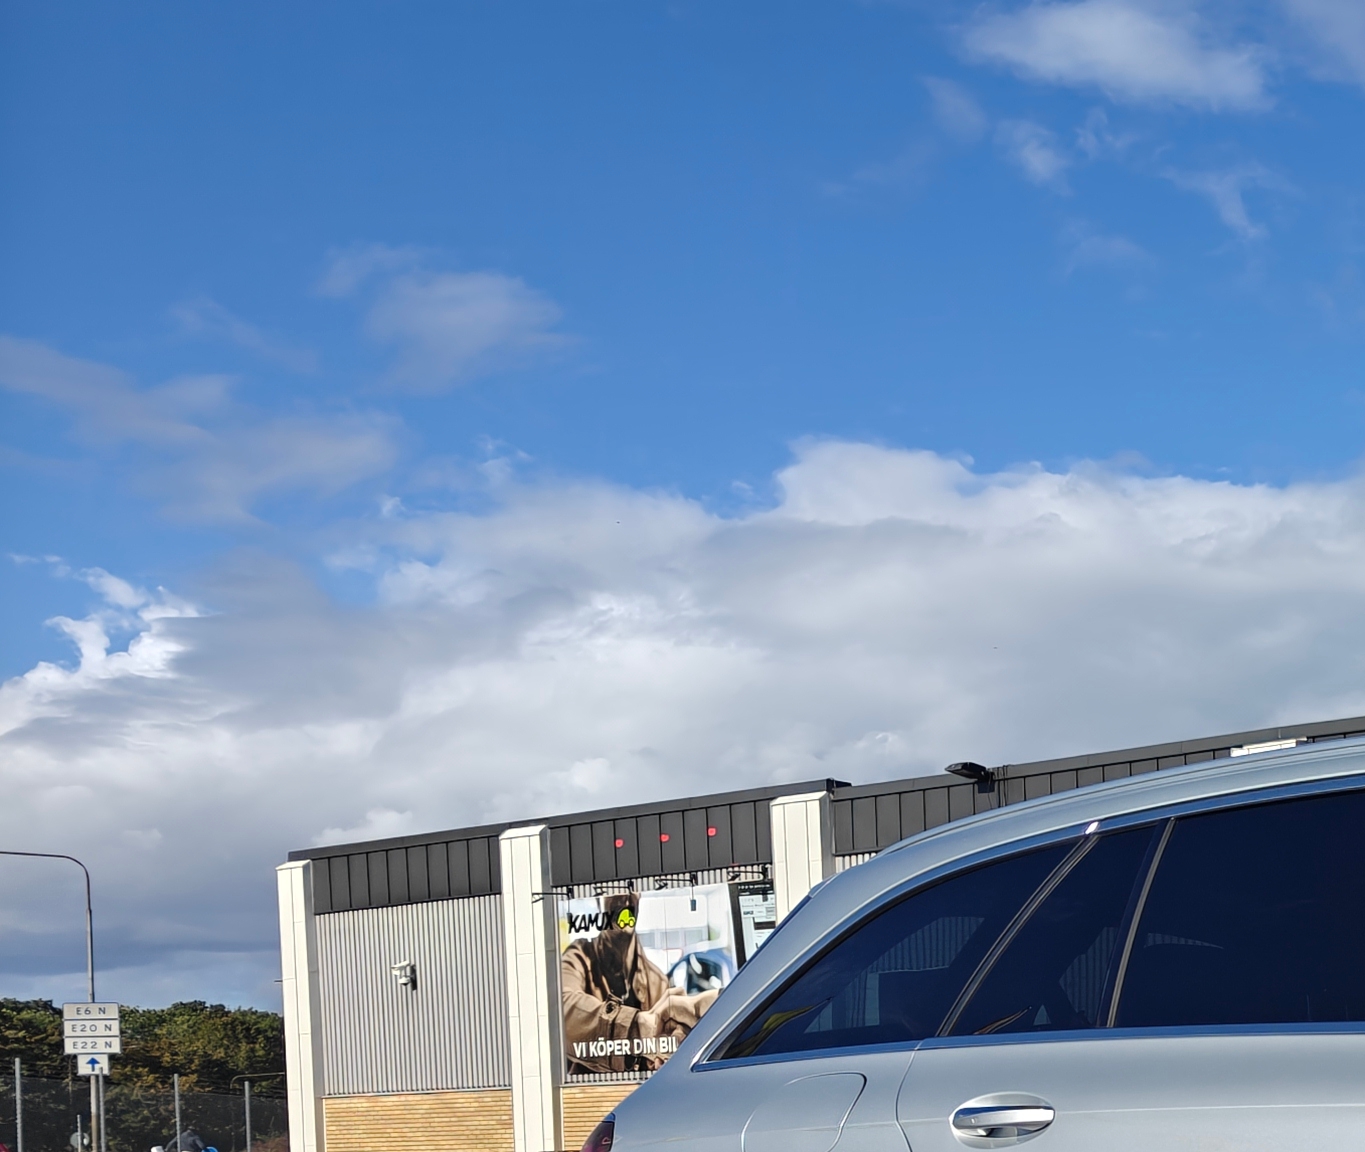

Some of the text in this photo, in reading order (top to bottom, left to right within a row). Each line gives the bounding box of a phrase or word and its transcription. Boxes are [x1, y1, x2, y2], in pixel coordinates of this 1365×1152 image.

[567, 911, 614, 934] KAMUX
[76, 1007, 106, 1015] E6 N
[71, 1024, 112, 1032] E20 N
[73, 1041, 112, 1049] E22 N
[573, 1036, 681, 1058] VI KÖPER DIN BIL
